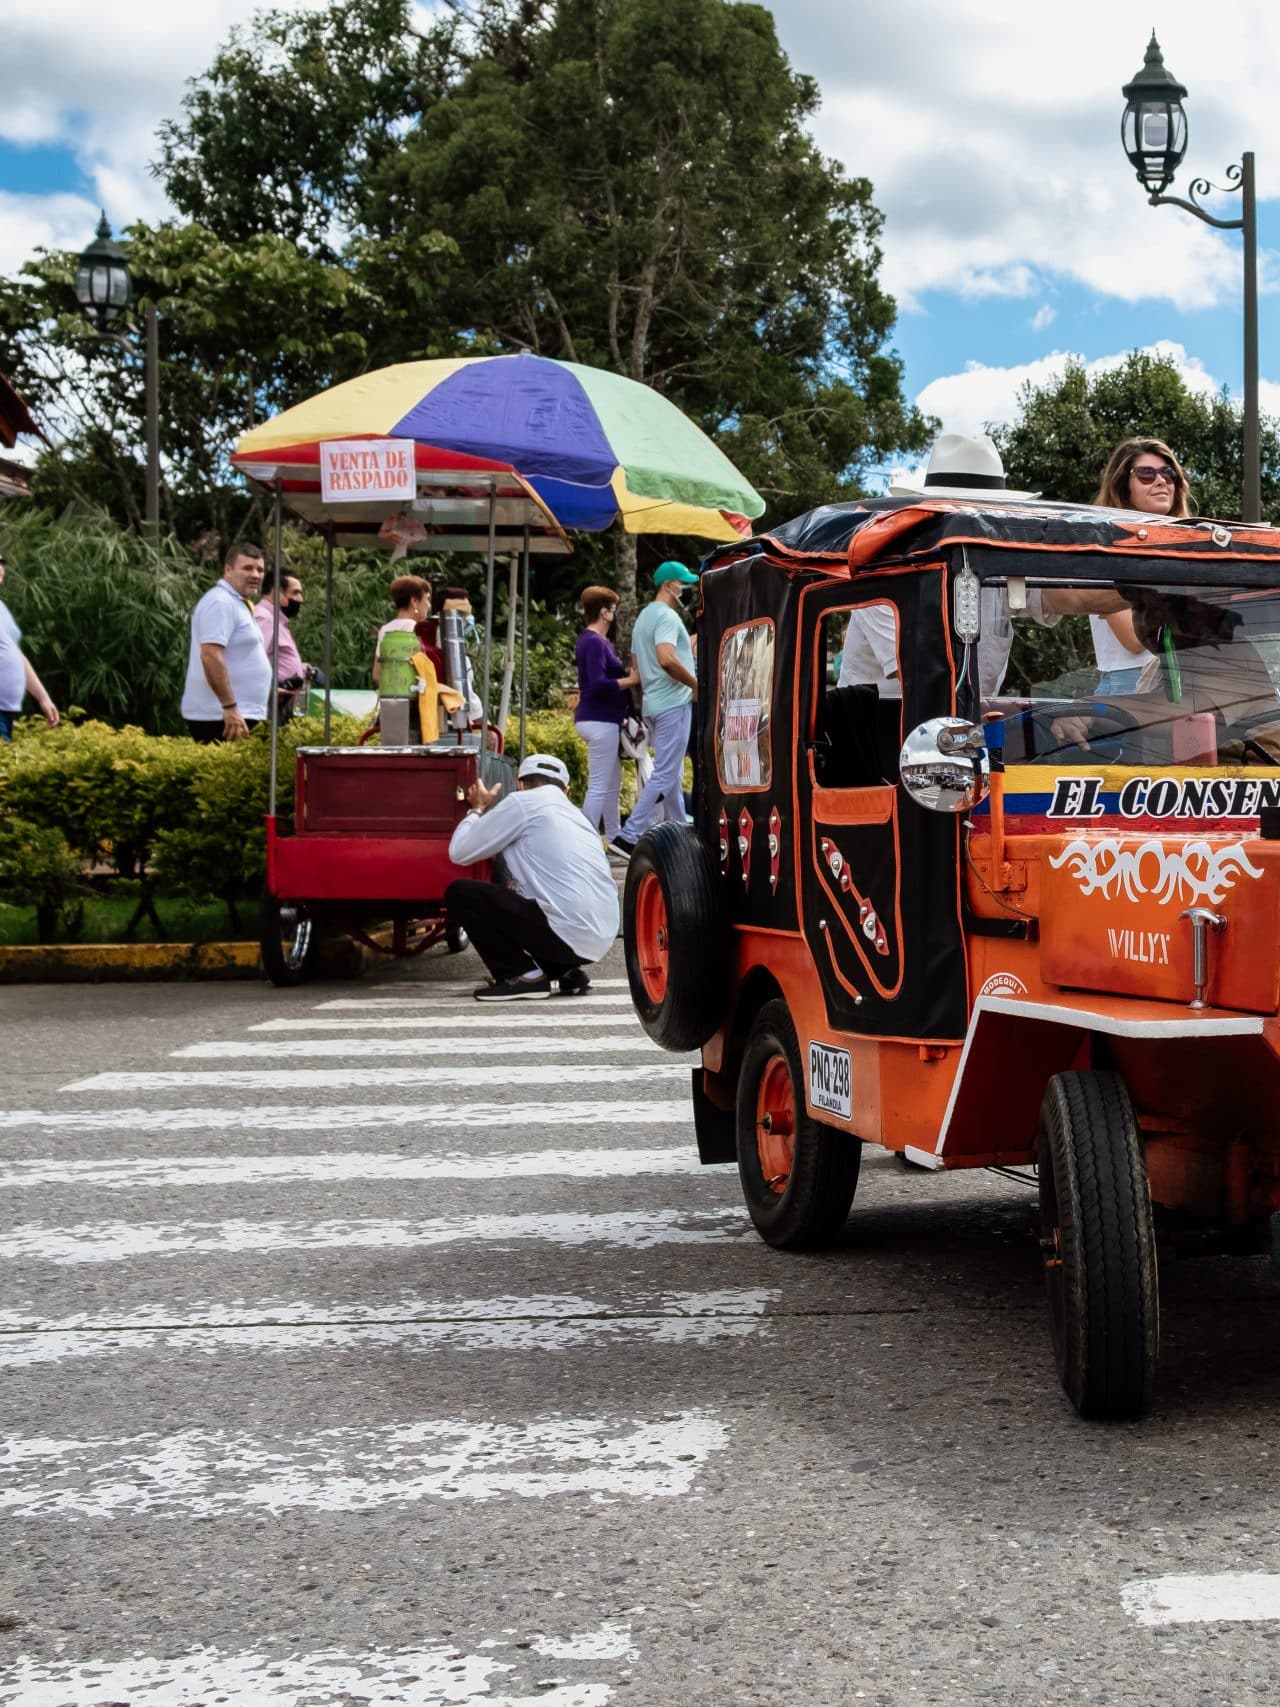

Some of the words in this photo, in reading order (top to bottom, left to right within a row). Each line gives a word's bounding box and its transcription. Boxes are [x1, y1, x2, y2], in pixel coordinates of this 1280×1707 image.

[329, 452, 379, 470] VENTA
[385, 450, 407, 469] DE
[330, 470, 408, 490] RASPADO
[1047, 777, 1104, 818] EL
[1107, 928, 1170, 965] WILLYS
[811, 1049, 831, 1094] PNQ
[832, 1055, 850, 1098] 298
[819, 1094, 842, 1112] FILANDIA
